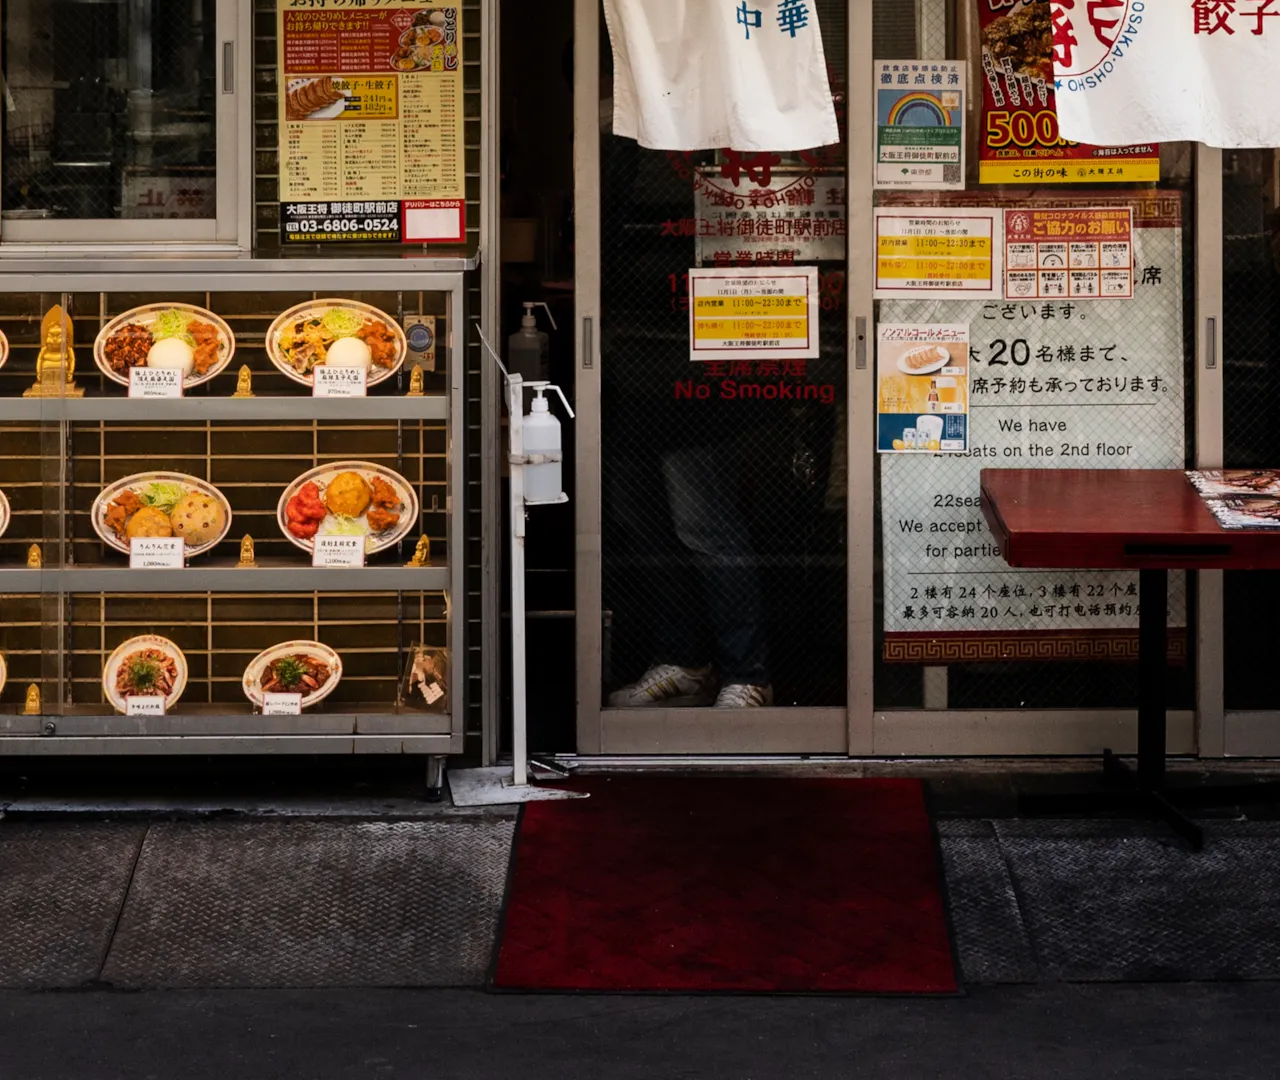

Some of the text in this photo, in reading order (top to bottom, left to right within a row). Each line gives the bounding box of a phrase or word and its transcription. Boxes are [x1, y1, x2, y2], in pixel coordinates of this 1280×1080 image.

[882, 64, 958, 73] 飲食店等感染防止
[881, 73, 959, 85] 徹底点検済
[881, 151, 958, 160] 大阪王将御徒町駅前店
[1012, 166, 1124, 179] この街の味 大阪王将
[286, 202, 398, 214] 大阪王将 御徒町駅前店
[300, 219, 399, 232] 03-6806-0524
[1033, 220, 1130, 235] ご協力のお願い
[982, 304, 1087, 321] ございます。
[881, 327, 966, 337] ノンアルコールメニュー
[674, 379, 836, 404] No Smoking
[998, 419, 1068, 432] We have
[1003, 442, 1133, 457] on the 2nd floor
[899, 520, 983, 536] We accept
[925, 544, 949, 558] for
